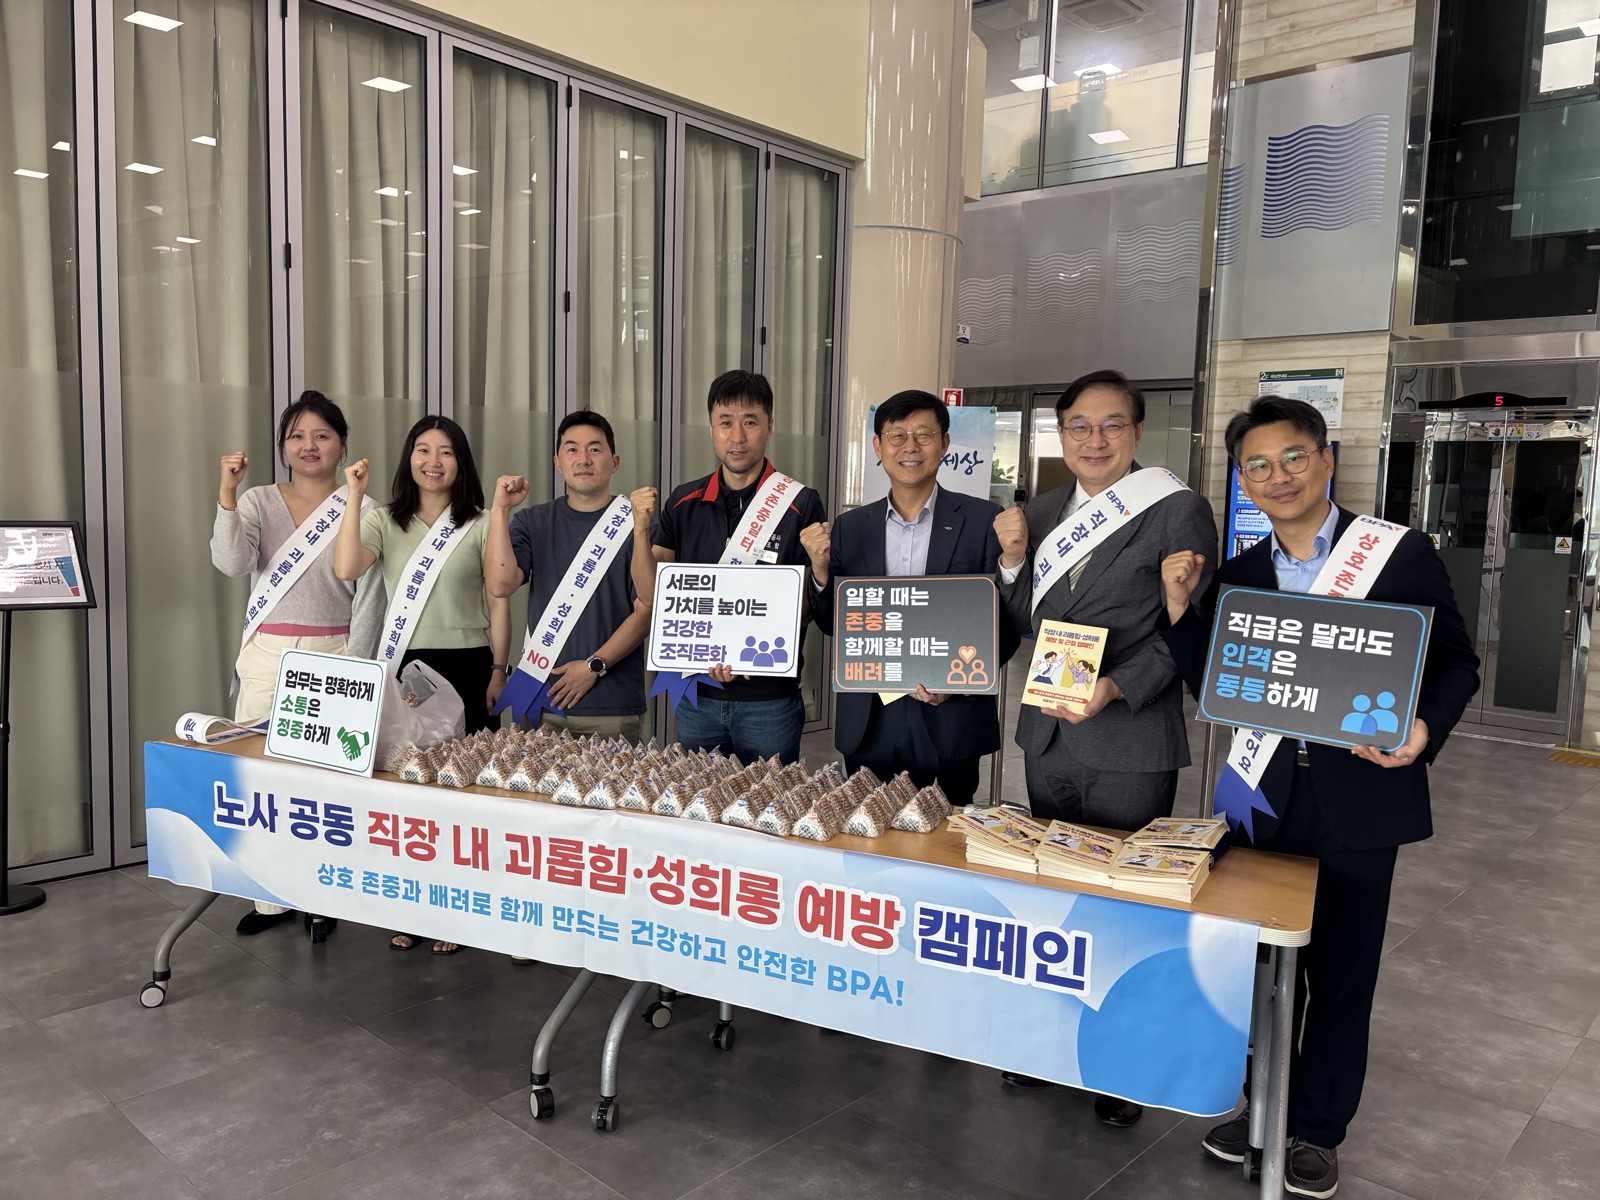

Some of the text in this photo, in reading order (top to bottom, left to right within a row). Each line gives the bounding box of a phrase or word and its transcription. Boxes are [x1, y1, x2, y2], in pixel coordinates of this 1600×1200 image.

[1495, 396, 1504, 406] 5
[1105, 489, 1126, 515] BPA
[1359, 517, 1394, 531] BPA
[431, 518, 456, 552] 장내
[666, 574, 717, 592] 서로의
[664, 597, 768, 617] 가치를 높이는
[845, 586, 930, 607] 일할 때는
[662, 619, 713, 639] 건강한
[845, 611, 903, 632] 존중을
[1227, 611, 1394, 656] 직급은 달라도
[659, 642, 727, 663] 조직문화
[845, 637, 950, 657] 함께할 때는
[527, 649, 550, 670] NO
[1222, 643, 1297, 676] 인격은
[844, 662, 903, 682] 배려를
[284, 670, 375, 702] 업무는 명확하게
[1216, 672, 1319, 713] 동등하게
[280, 694, 321, 718] 소통은
[276, 717, 331, 745] 정중하게
[216, 785, 278, 833] 노사
[287, 796, 355, 847] 공동
[367, 809, 440, 862] 직장
[453, 824, 489, 872] 내
[799, 884, 901, 950] 예방
[918, 906, 1088, 991] 캠페인
[317, 863, 905, 1007] 상호 존중과 배려로 함께 만드는 건강하고 안전한 BPA!
